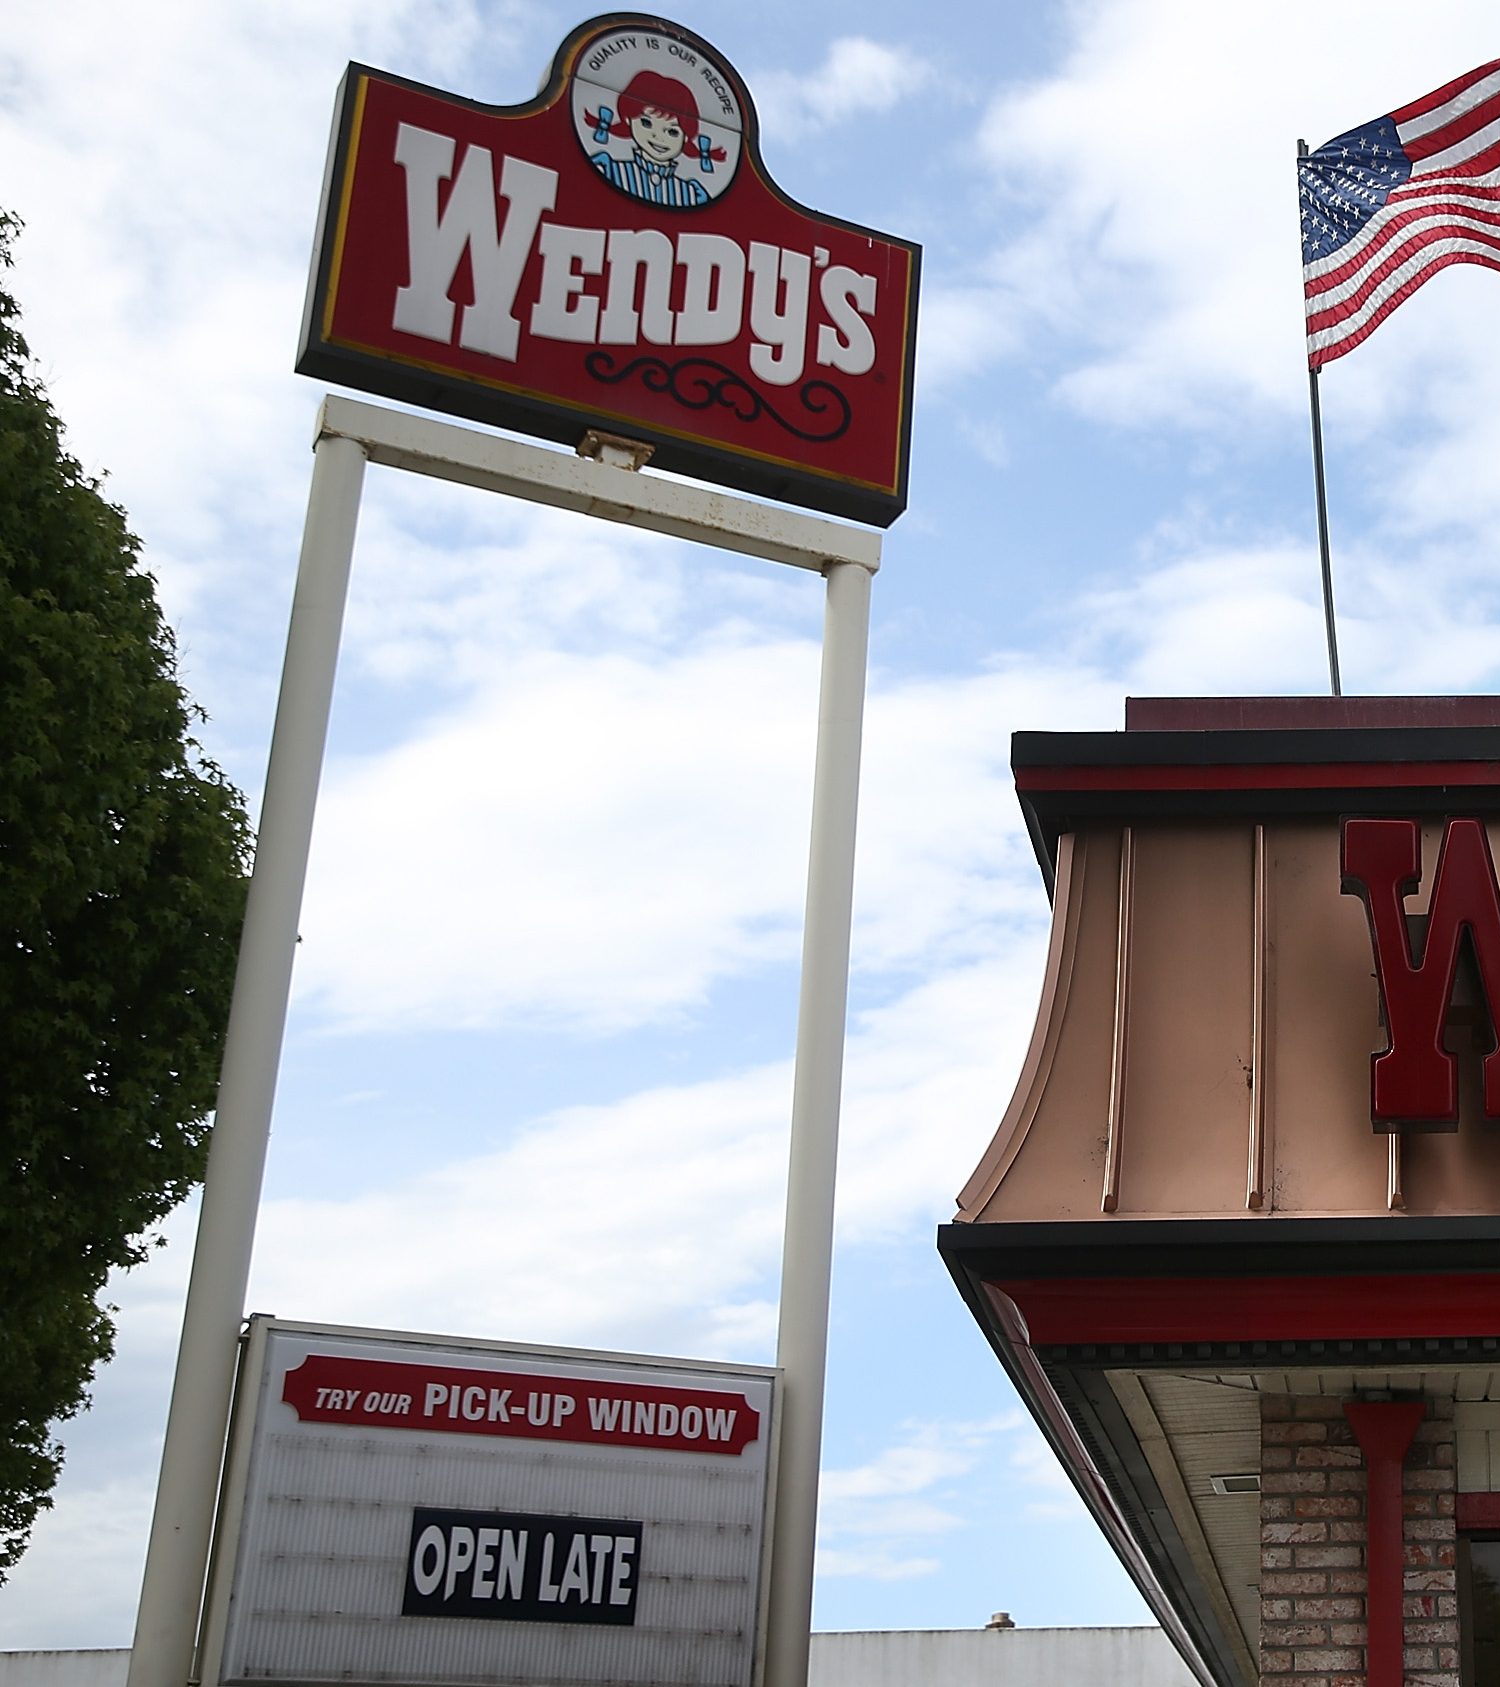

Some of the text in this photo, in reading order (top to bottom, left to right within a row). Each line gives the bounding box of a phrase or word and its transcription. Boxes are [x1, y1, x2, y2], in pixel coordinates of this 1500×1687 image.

[588, 38, 734, 115] QUALITY IS OUR RECIPE
[315, 1383, 738, 1442] TRY OUR PICK-UP WINDOW
[413, 1524, 636, 1606] OPEN LATE
